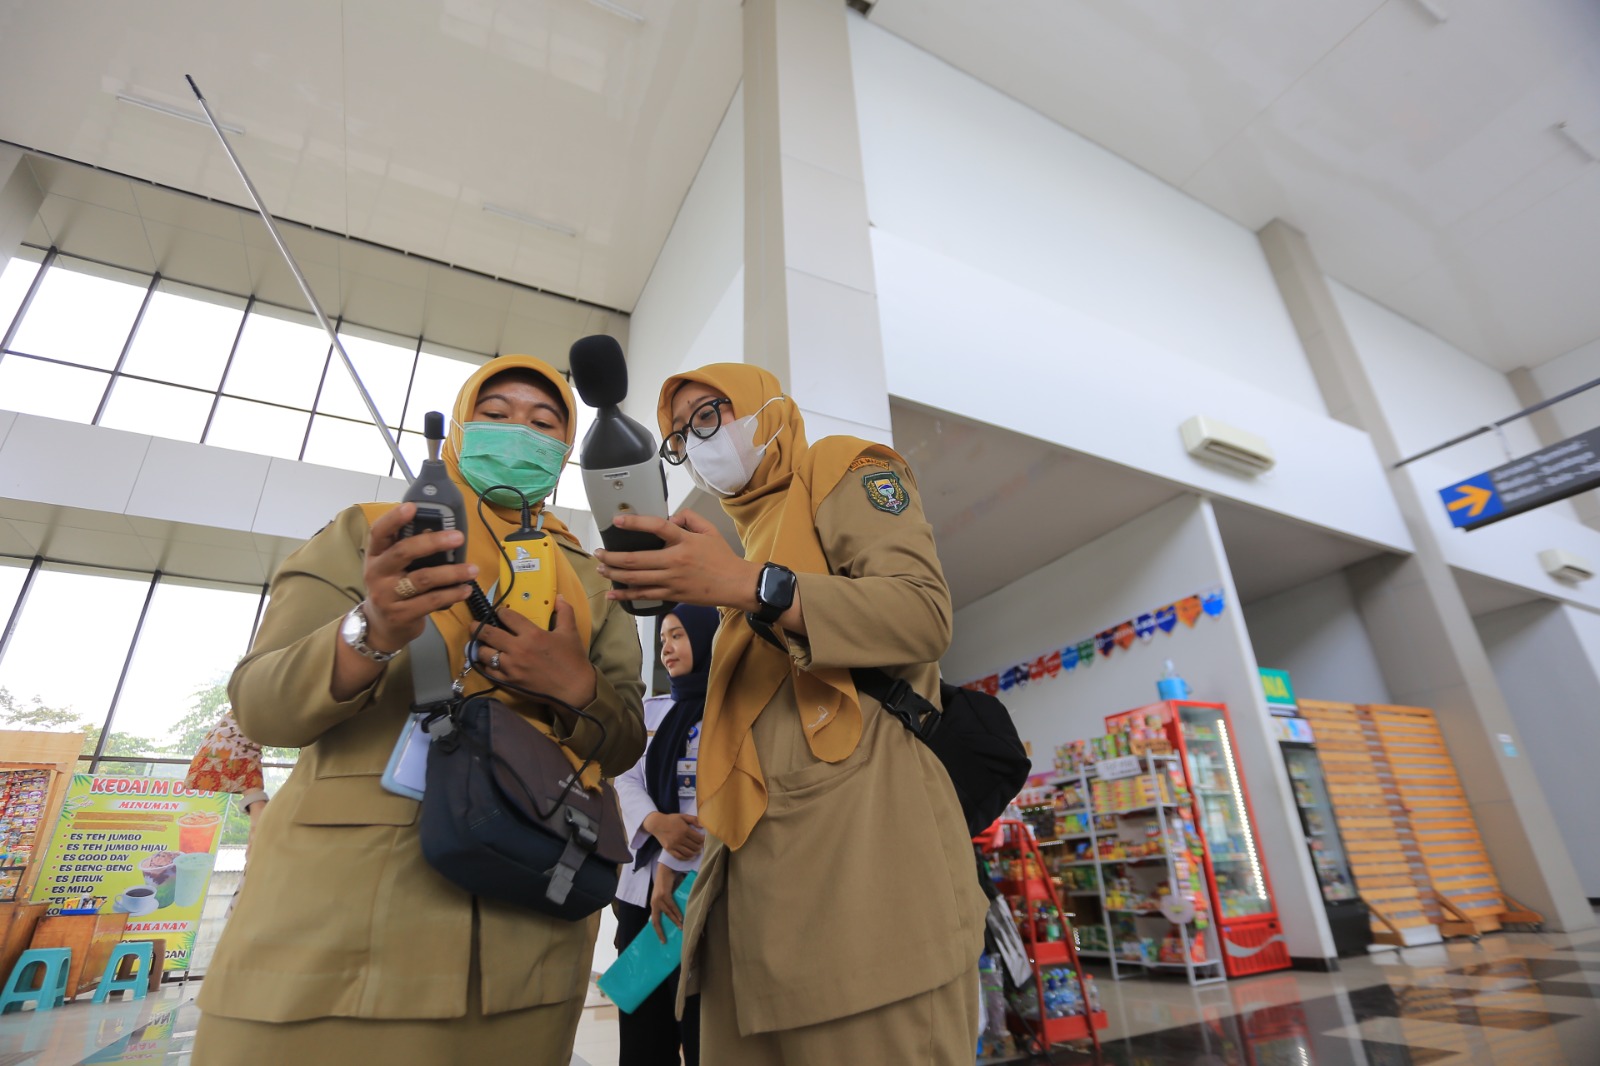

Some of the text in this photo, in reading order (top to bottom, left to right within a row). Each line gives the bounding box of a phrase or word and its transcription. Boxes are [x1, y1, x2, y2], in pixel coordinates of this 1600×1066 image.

[91, 778, 149, 794] KEDAI
[151, 780, 169, 795] M
[118, 801, 180, 810] MINUMAN
[70, 833, 142, 842] ES TEH JUMBO
[66, 843, 168, 854] ES TEH JUMBO HIJAU
[62, 853, 76, 861] ES
[59, 864, 73, 872] ES
[70, 875, 104, 884] JERUK
[67, 885, 94, 893] MILO
[124, 922, 188, 931] MAKANAN
